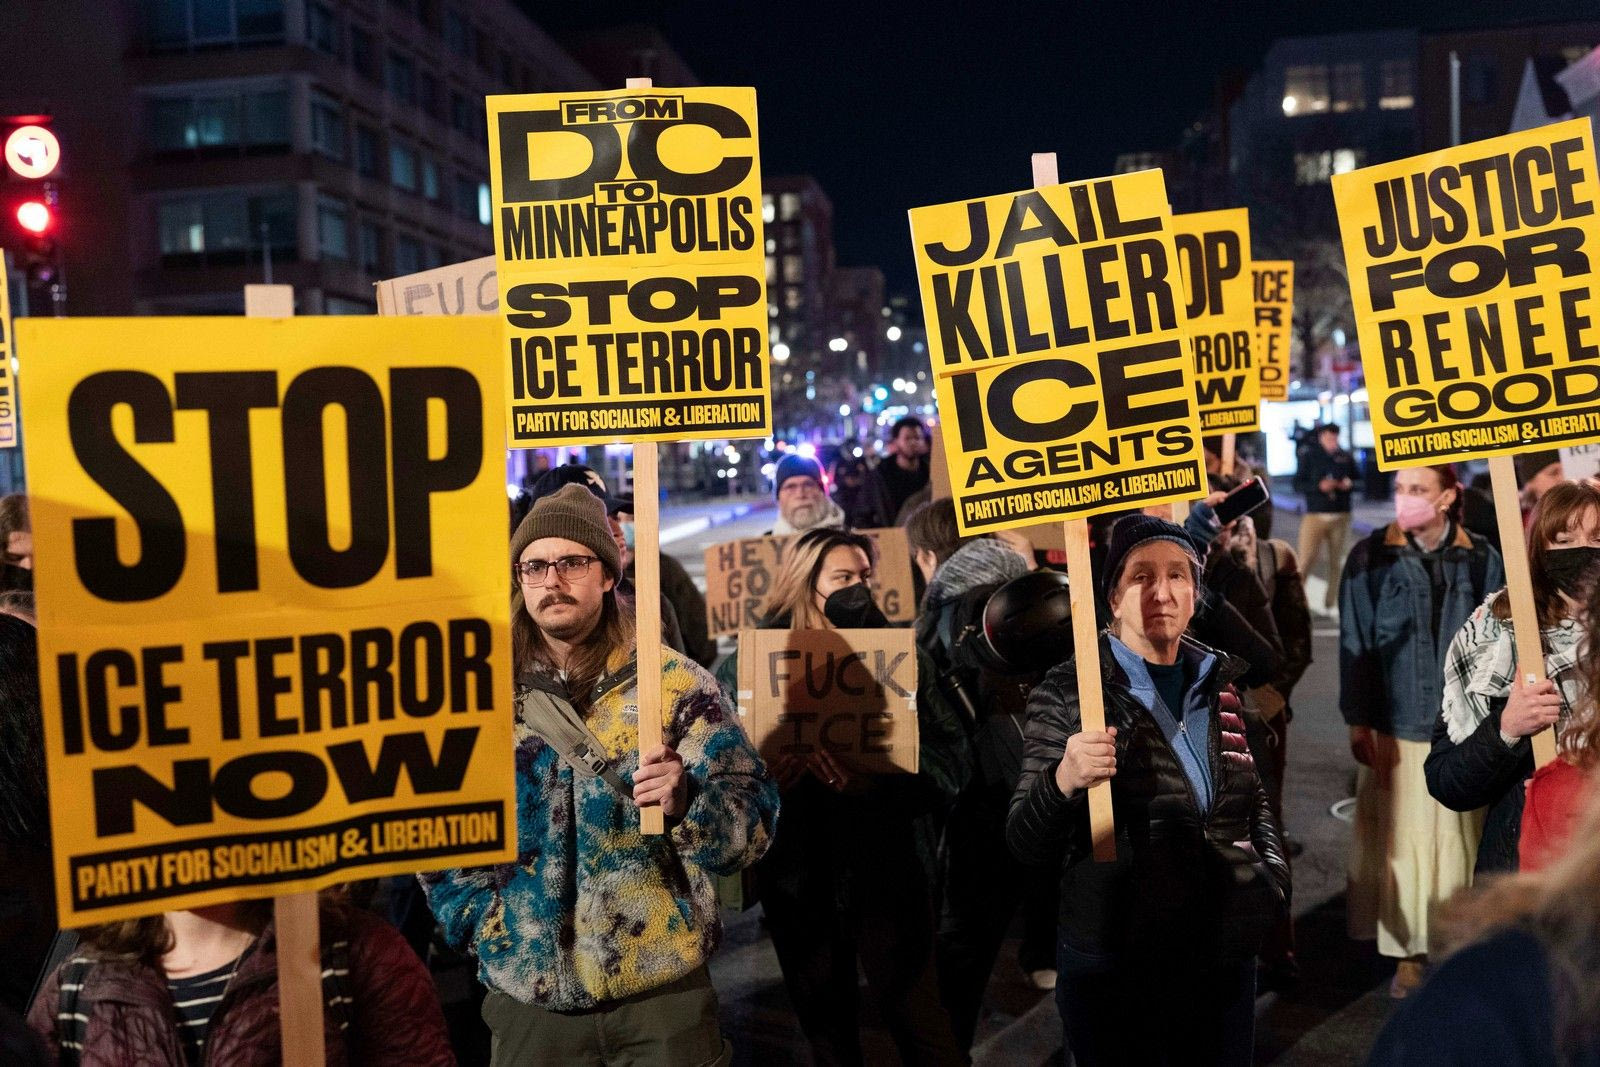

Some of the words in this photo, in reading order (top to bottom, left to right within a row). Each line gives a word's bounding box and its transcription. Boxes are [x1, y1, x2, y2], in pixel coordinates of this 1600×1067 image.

[566, 98, 678, 124] FROM
[498, 102, 753, 204] DC
[599, 182, 654, 203] TO
[924, 180, 1164, 267] JAIL
[1363, 136, 1595, 258] JUSTICE
[501, 196, 755, 261] MINNEAPOLIS
[403, 269, 500, 316] FUC
[932, 238, 1178, 365] KILLER
[1366, 226, 1592, 312] FOR
[506, 275, 762, 329] STOP
[510, 334, 582, 400] ICE
[587, 327, 763, 397] TERROR
[1378, 287, 1600, 389] RENEE
[516, 411, 561, 433] PARTY
[562, 409, 589, 431] FOR
[590, 407, 661, 430] SOCIALISM
[664, 407, 681, 426] &
[683, 403, 760, 425] LIBERATION
[951, 340, 1190, 453] ICE
[1383, 365, 1600, 428] GOOD
[965, 425, 1195, 488] AGENTS
[1384, 435, 1426, 457] PARTY
[1426, 433, 1452, 452] FOR
[1452, 423, 1520, 448] SOCIALISM
[1521, 422, 1540, 440] &
[1540, 412, 1600, 437] LIBERATI
[67, 365, 484, 604] STOP
[965, 496, 1006, 522] PARTY
[1004, 493, 1034, 515] FOR
[1034, 483, 1101, 510] SOCIALISM
[1103, 480, 1121, 499] &
[1121, 467, 1196, 496] LIBERATION
[718, 538, 789, 572] HEY
[56, 643, 191, 756] ICE
[202, 616, 494, 741] TERROR
[768, 649, 912, 699] FUCK
[777, 711, 894, 754] ICE
[92, 726, 481, 839] NOW
[77, 855, 163, 902] PARTY
[162, 852, 213, 888] FOR
[213, 834, 337, 878] SOCIALISM
[340, 827, 369, 859] &
[371, 812, 498, 855] LIBERATION
